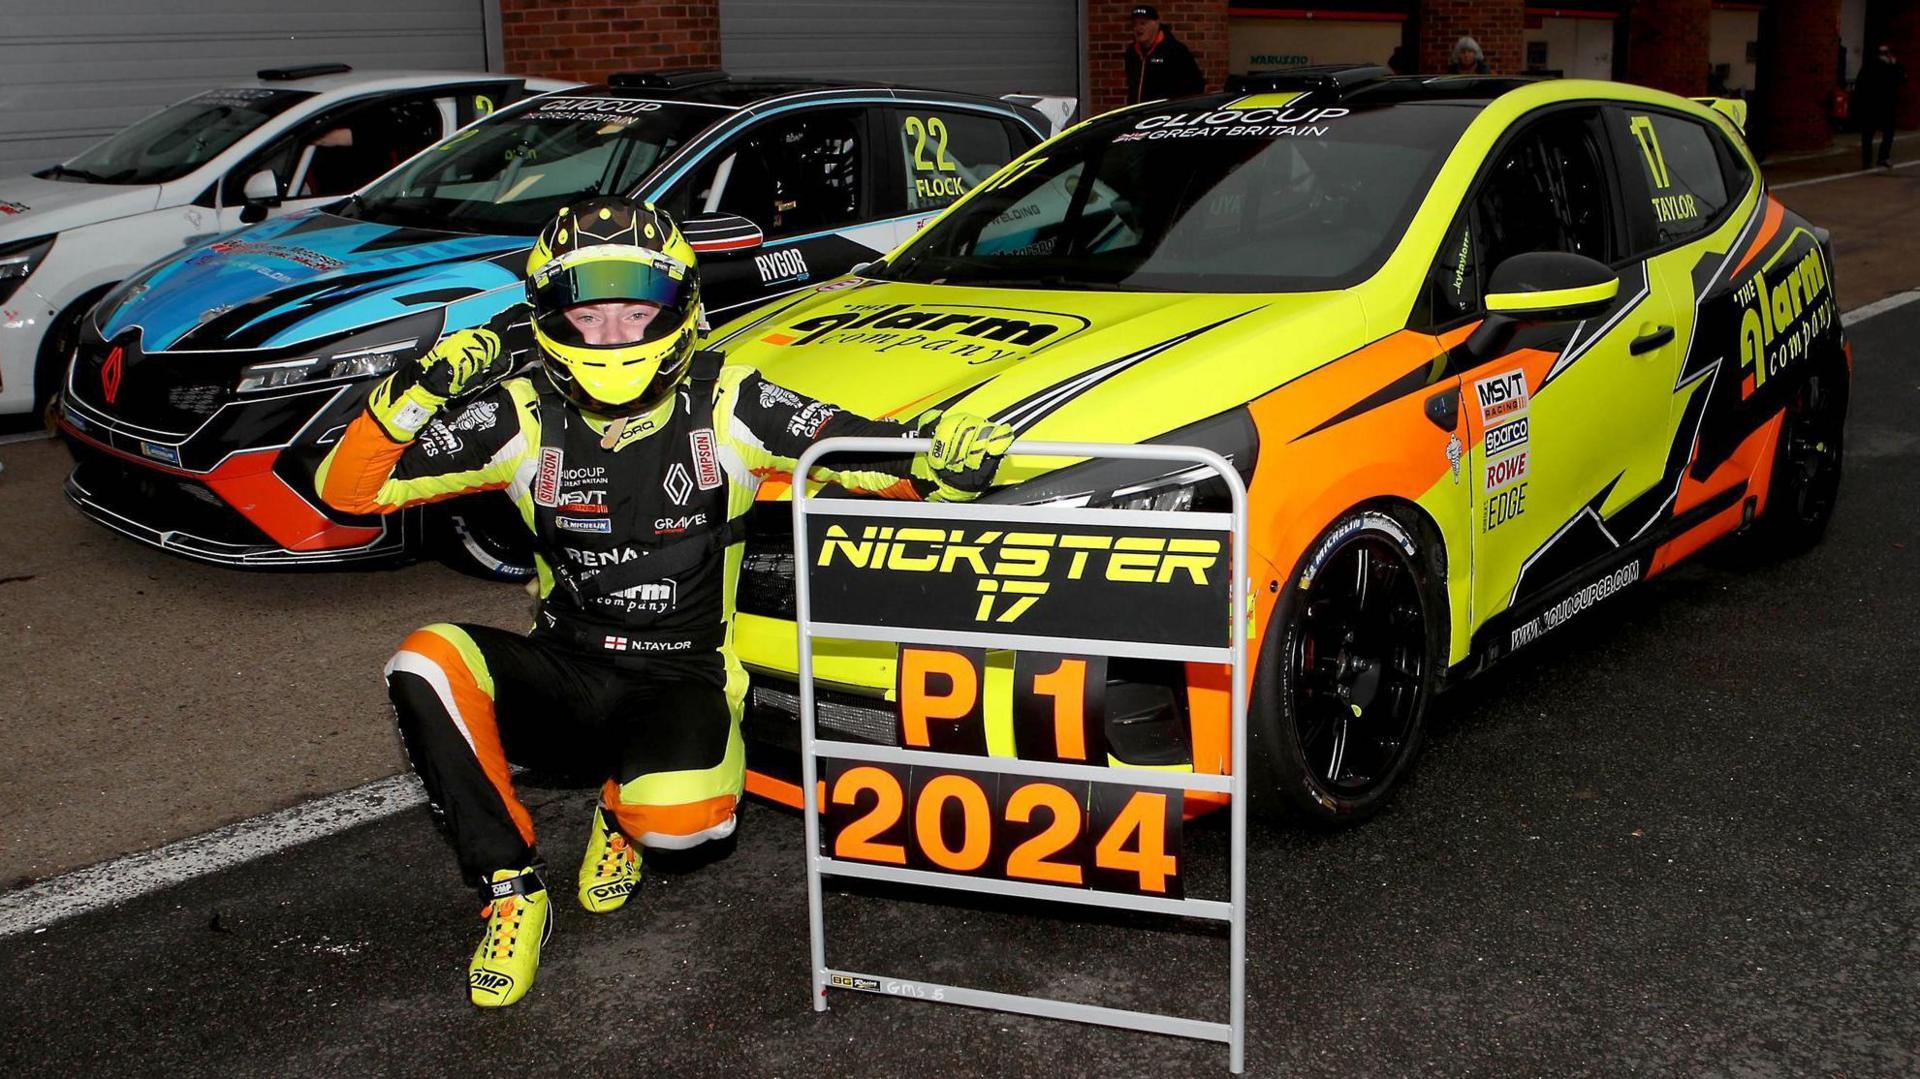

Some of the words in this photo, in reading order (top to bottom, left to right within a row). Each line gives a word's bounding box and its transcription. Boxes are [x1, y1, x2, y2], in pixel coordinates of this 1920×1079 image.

[539, 112, 580, 121] GREAT
[579, 113, 639, 125] BRITAIN
[540, 99, 662, 114] CLIOCUP
[1135, 108, 1350, 130] CLIOCUP
[905, 116, 956, 171] 22
[1148, 127, 1228, 140] GREAT
[1225, 126, 1329, 137] BRITAIN
[1630, 116, 1670, 188] 17
[916, 177, 964, 197] FLOCK
[1651, 194, 1697, 222] TAYLOR
[754, 248, 808, 282] RYGOR
[1737, 279, 1756, 308] THE
[819, 333, 1016, 365] company
[1770, 297, 1832, 376] company
[1477, 373, 1524, 406] MSVT
[1484, 402, 1518, 421] RACING
[1486, 421, 1528, 449] sparco
[700, 436, 716, 484] SIMPSON
[1487, 453, 1527, 489] ROWE
[540, 453, 557, 501] SIMPSON
[1487, 482, 1528, 530] EDGE
[817, 524, 1221, 586] NICKSTER
[1315, 519, 1361, 563] MICHELIN
[564, 547, 649, 567] RENA
[597, 597, 668, 613] company
[975, 578, 1050, 623] 17
[631, 641, 692, 650] N.TAYLOR
[832, 766, 1177, 893] 2024
[493, 883, 512, 895] OMP
[593, 880, 634, 898] OMP
[469, 972, 508, 990] OMP
